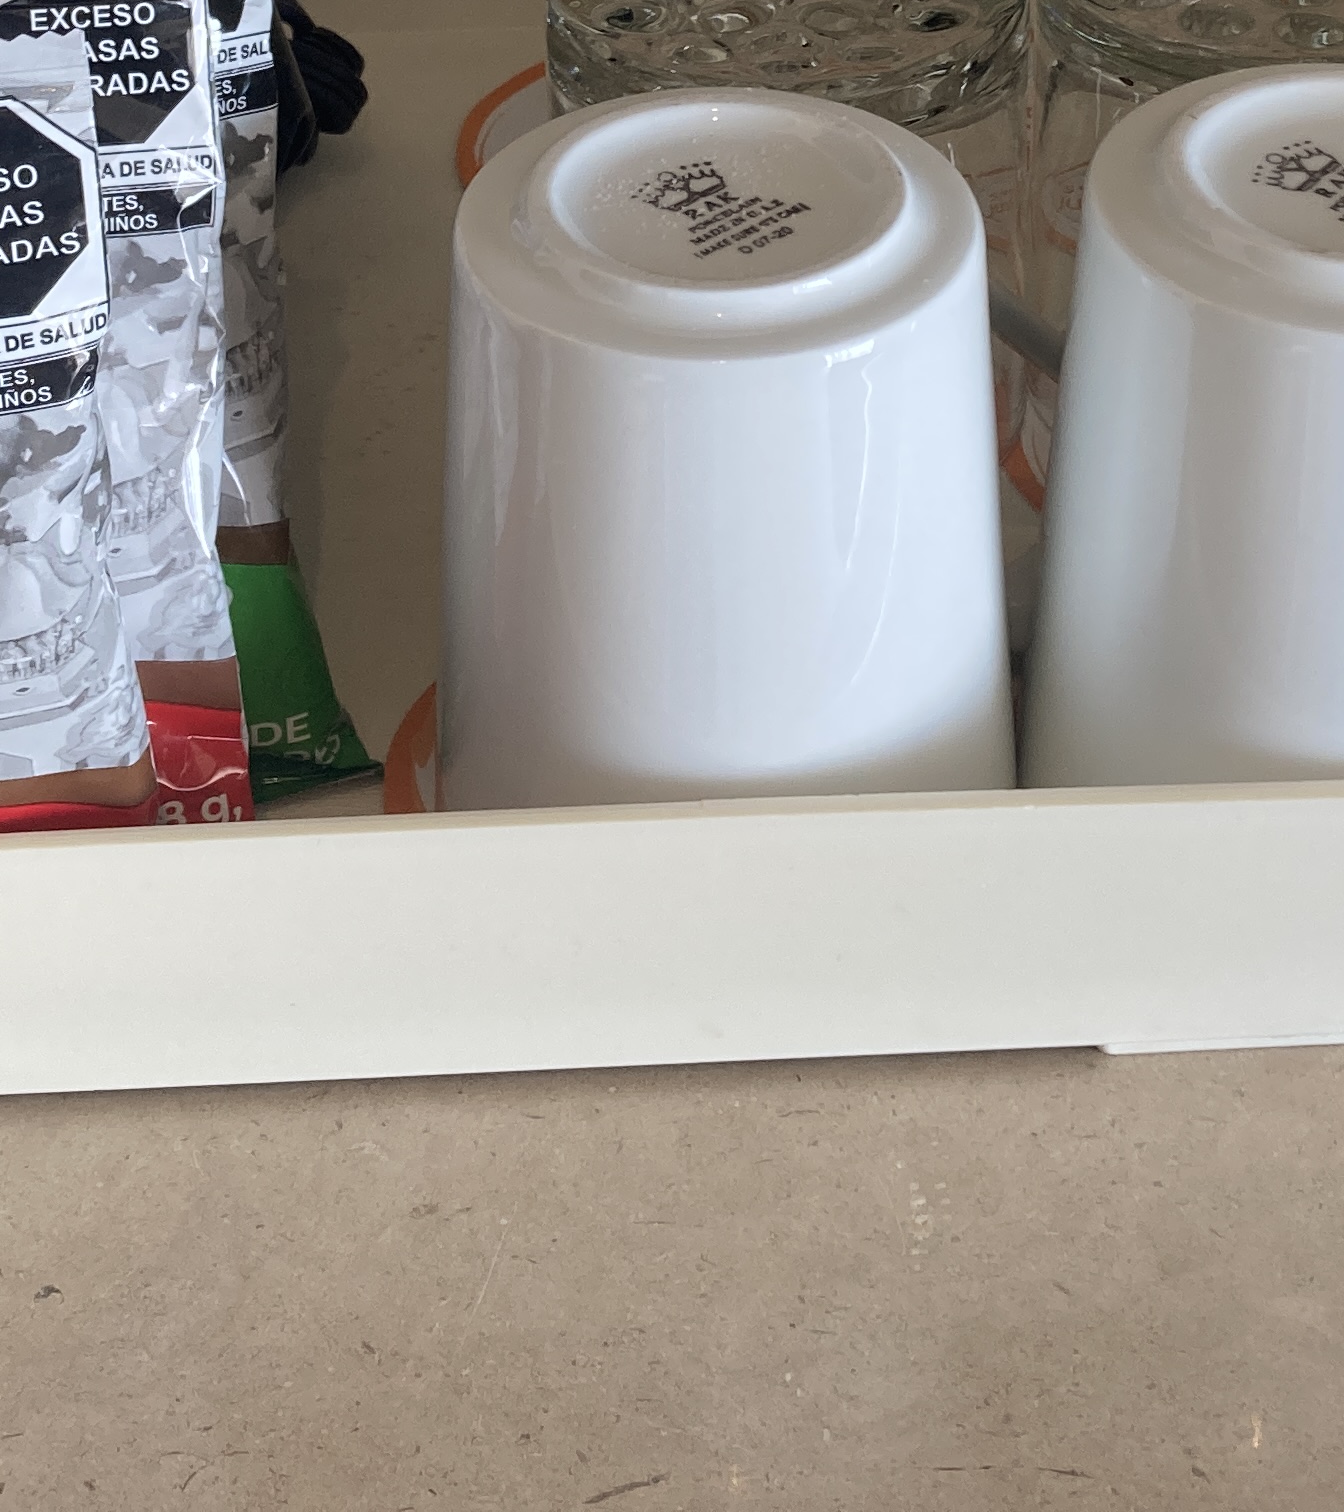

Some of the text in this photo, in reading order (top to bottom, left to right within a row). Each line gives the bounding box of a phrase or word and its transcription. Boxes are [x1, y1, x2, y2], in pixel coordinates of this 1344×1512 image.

[29, 1, 156, 32] EXCESO
[84, 36, 160, 63] ASAS
[217, 40, 269, 65] DE SAL
[88, 68, 191, 97] RADAS
[217, 95, 248, 114] ÑOS
[119, 160, 147, 178] DE
[4, 331, 36, 353] DE
[39, 312, 108, 347] SALUD
